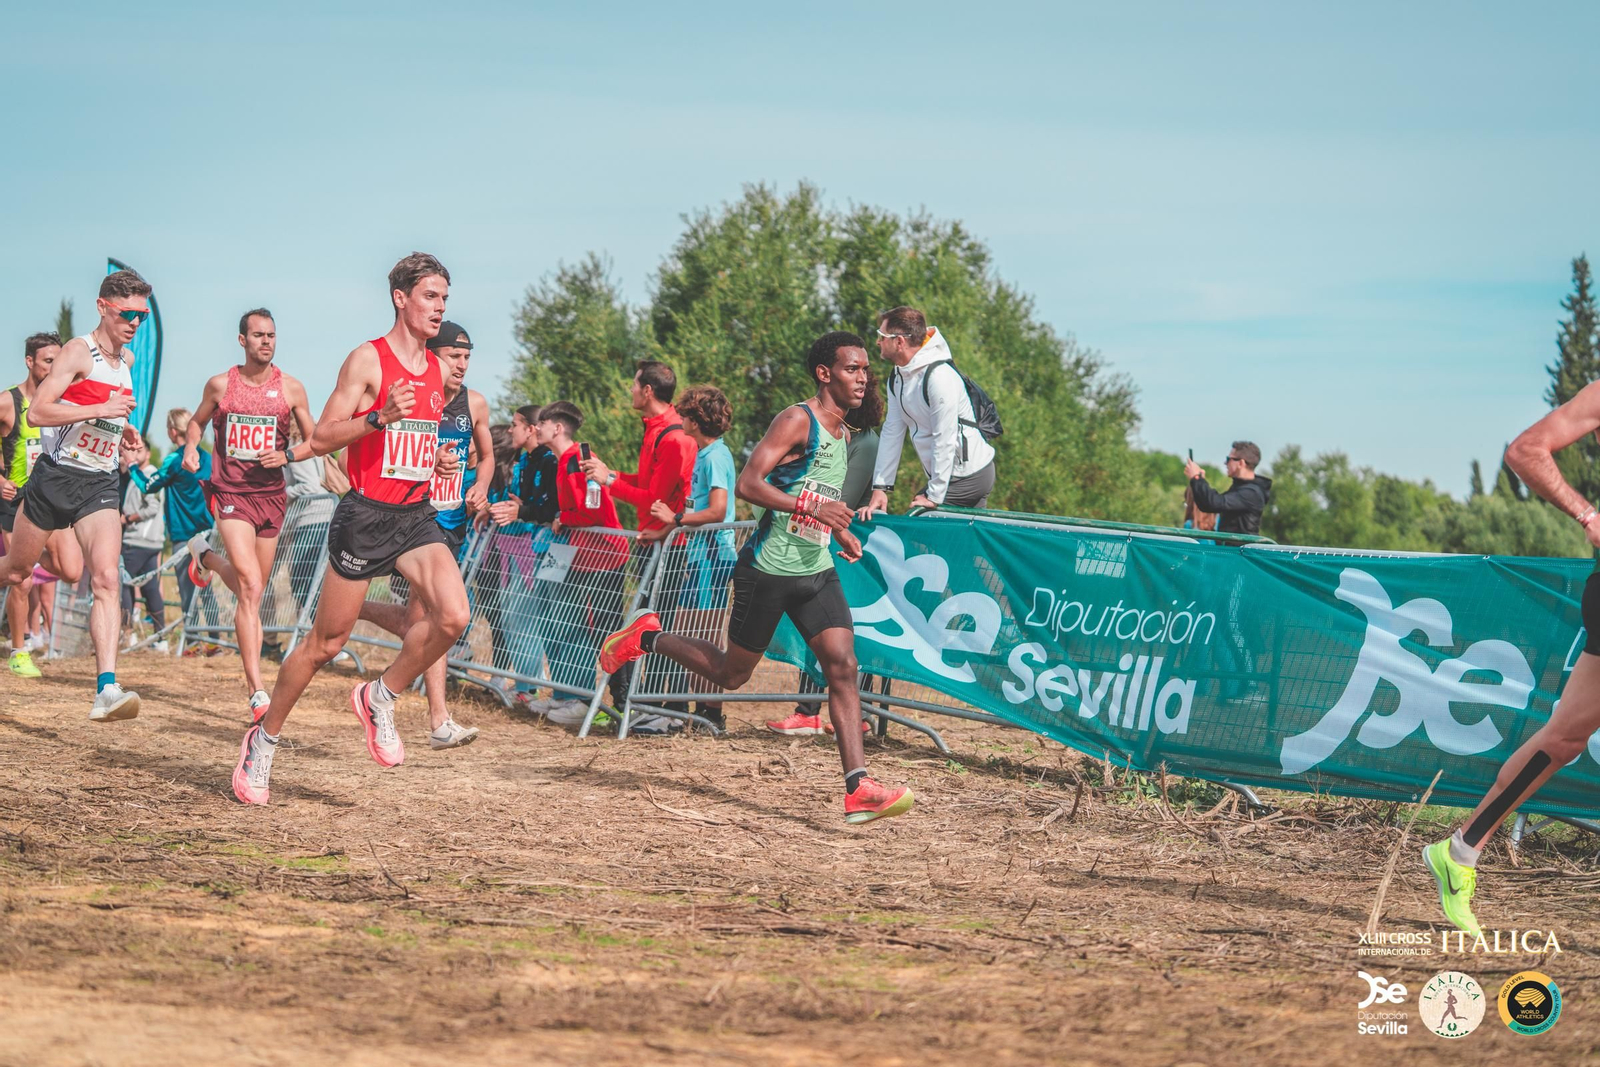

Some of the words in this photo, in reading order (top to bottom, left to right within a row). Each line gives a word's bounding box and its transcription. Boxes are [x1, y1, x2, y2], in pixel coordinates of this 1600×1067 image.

[77, 432, 116, 458] 5115
[227, 423, 274, 451] ARCE
[386, 430, 437, 469] VIVES
[429, 471, 463, 502] RIKI
[1024, 586, 1216, 645] Diputación
[1002, 641, 1198, 735] Sevilla
